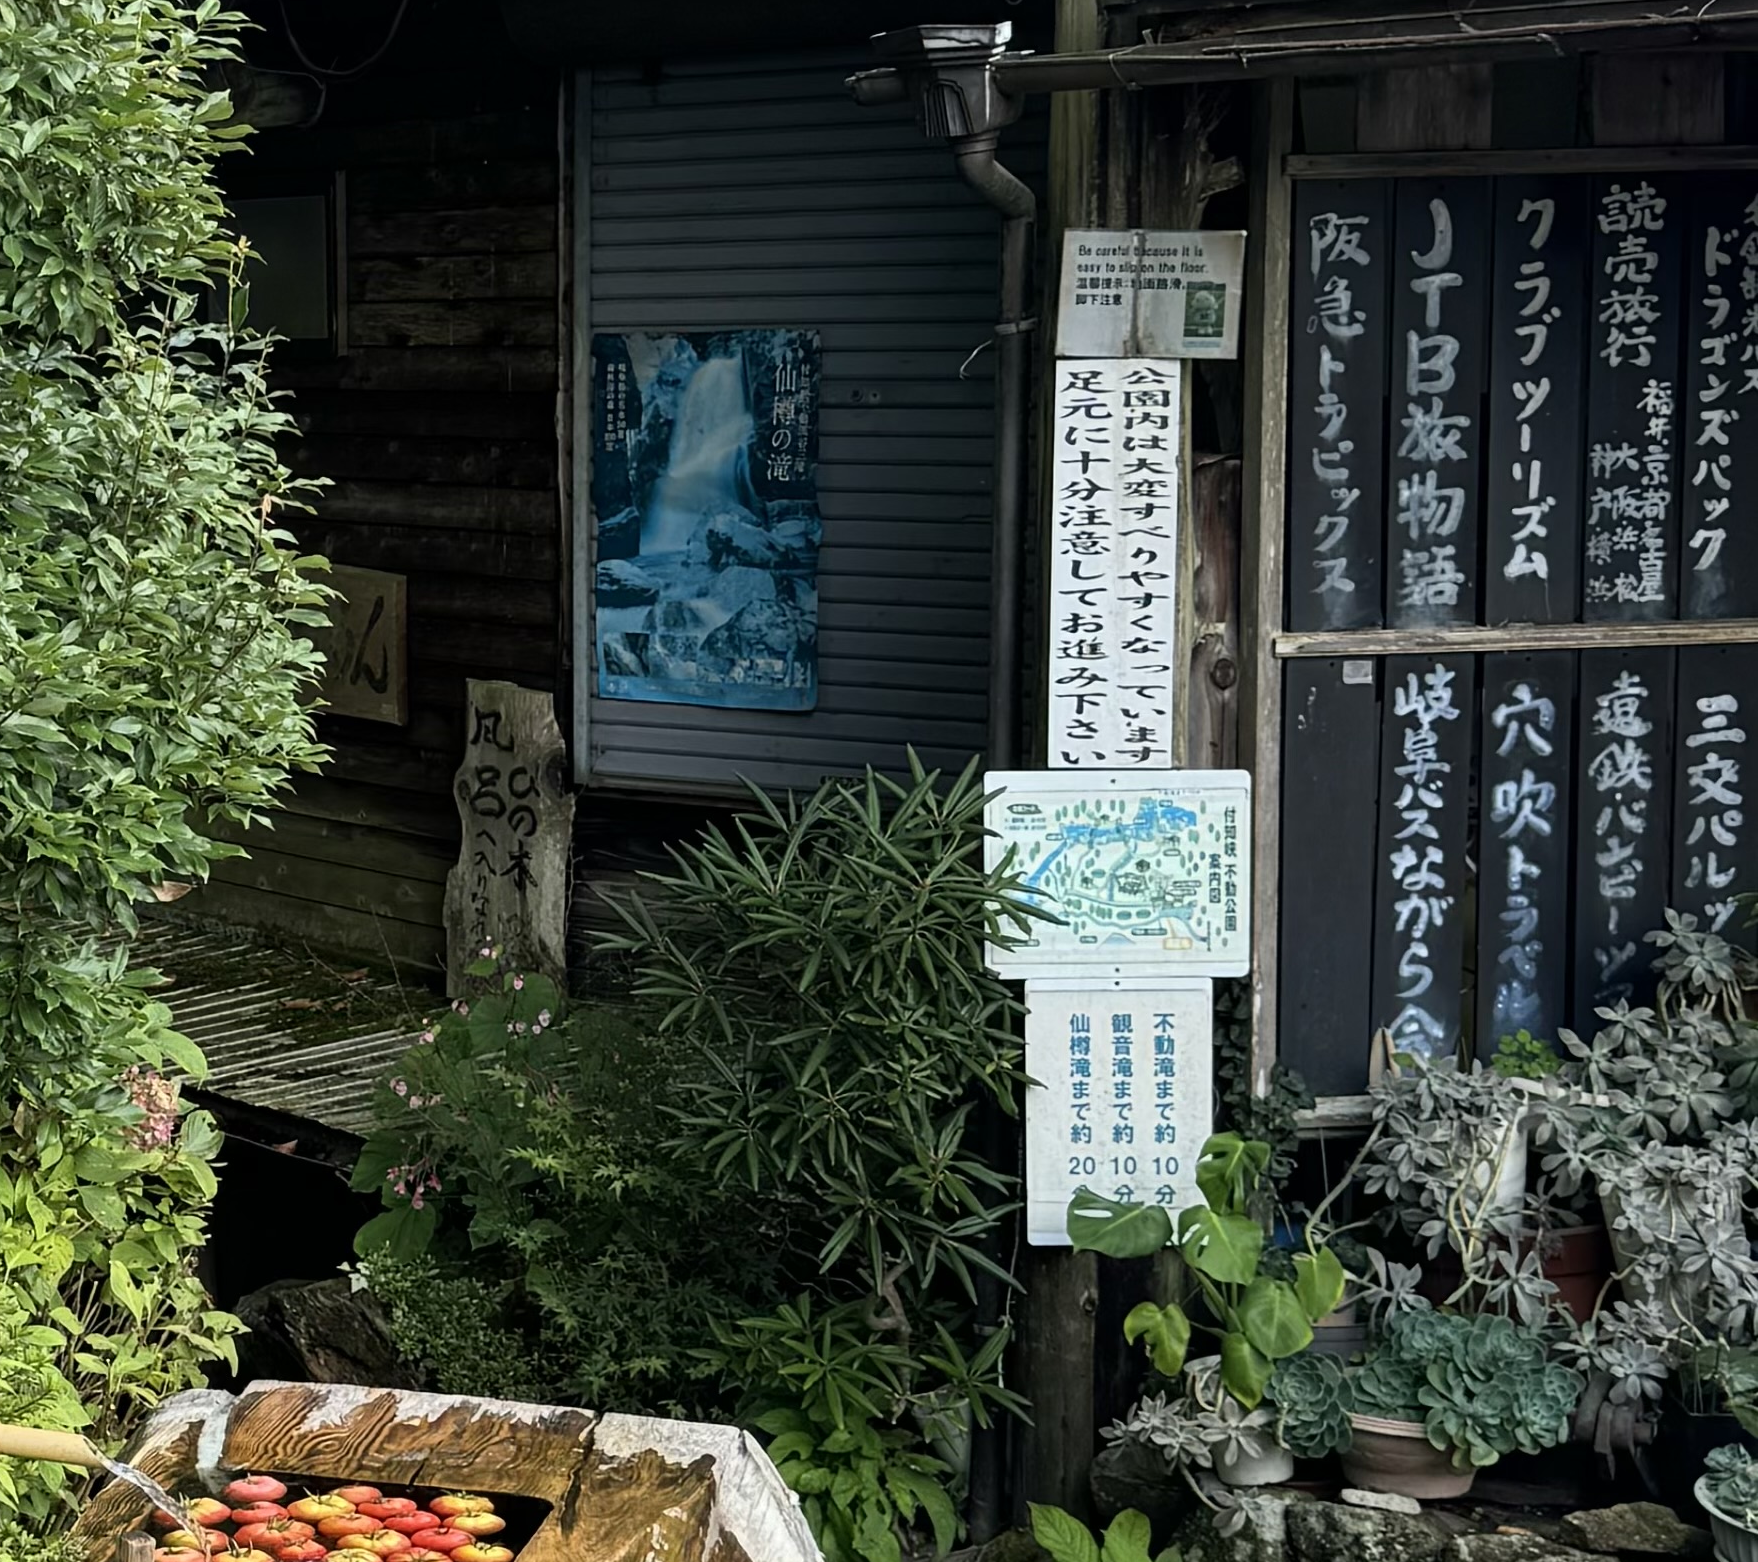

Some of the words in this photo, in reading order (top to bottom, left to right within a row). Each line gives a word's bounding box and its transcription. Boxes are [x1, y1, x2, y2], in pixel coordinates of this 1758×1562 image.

[1077, 264, 1100, 275] easy
[1105, 263, 1115, 274] to
[1159, 262, 1176, 274] the
[1078, 245, 1091, 257] Be
[1095, 244, 1129, 257] careful
[1181, 244, 1190, 256] it
[1195, 244, 1204, 256] is
[1307, 211, 1371, 594] 阪急トラピックス
[1397, 198, 1472, 606] JTB旅物語
[1503, 198, 1562, 580] クラブツーリズム
[1597, 182, 1667, 369] 読売旅行
[1688, 226, 1739, 571] ドラゴンズパック
[1055, 370, 1115, 765] 足元に十分注意してお進み下さい
[1115, 367, 1175, 764] 公園内は大変すべりやすくなっています
[1490, 682, 1557, 1027] 穴吹トラベル
